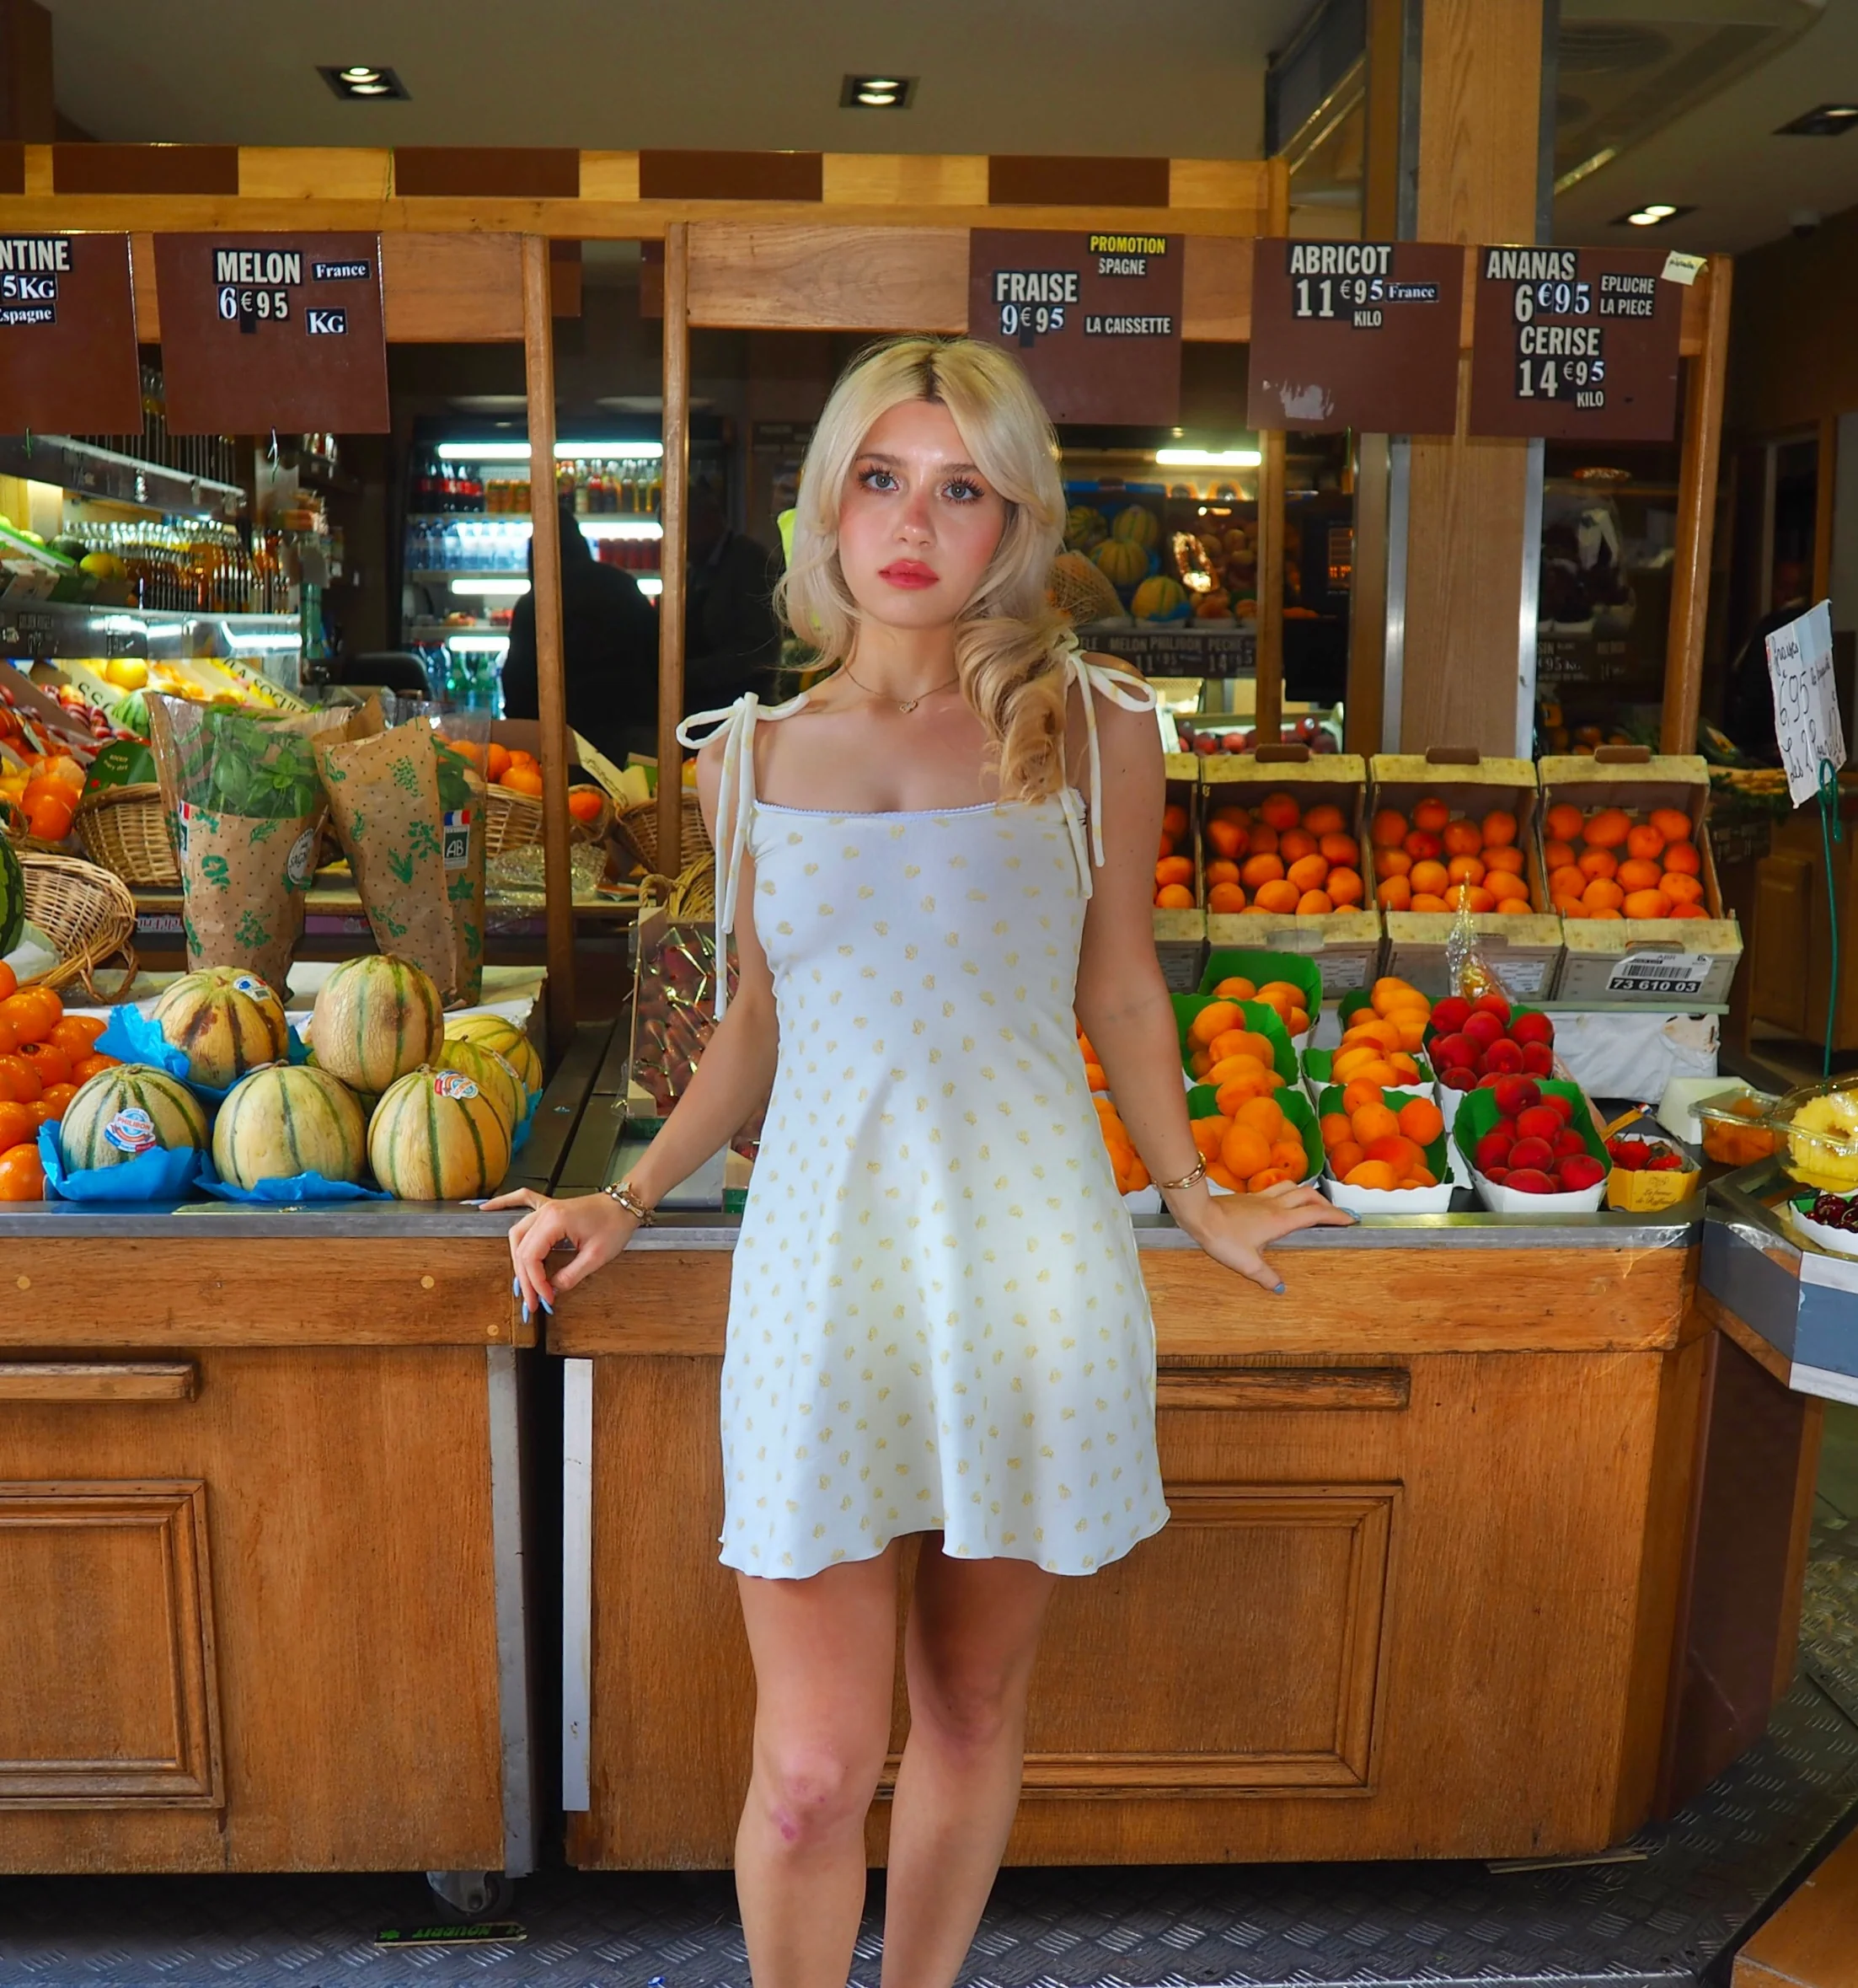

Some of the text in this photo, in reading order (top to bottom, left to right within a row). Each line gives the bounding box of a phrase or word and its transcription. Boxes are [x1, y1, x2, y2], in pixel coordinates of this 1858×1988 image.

[1090, 236, 1165, 254] PROMOTION
[0, 240, 70, 271] NTINE
[1290, 245, 1391, 275] ABRICOT
[217, 251, 301, 284] MELON
[316, 264, 366, 278] France
[1099, 257, 1146, 275] SPAGNE
[1486, 250, 1576, 281] ANANAS
[997, 273, 1078, 303] FRAISE
[1389, 286, 1435, 299] France
[1601, 276, 1656, 294] EPLUCHE
[1600, 297, 1653, 316] LA PIECE
[309, 312, 344, 334] KG
[1086, 317, 1171, 334] LA CAISSETTE
[1354, 311, 1383, 327] KILO
[1519, 325, 1601, 356] CERISE
[1577, 390, 1604, 408] KILO
[446, 839, 464, 857] AB
[1613, 978, 1697, 993] 73 610 03
